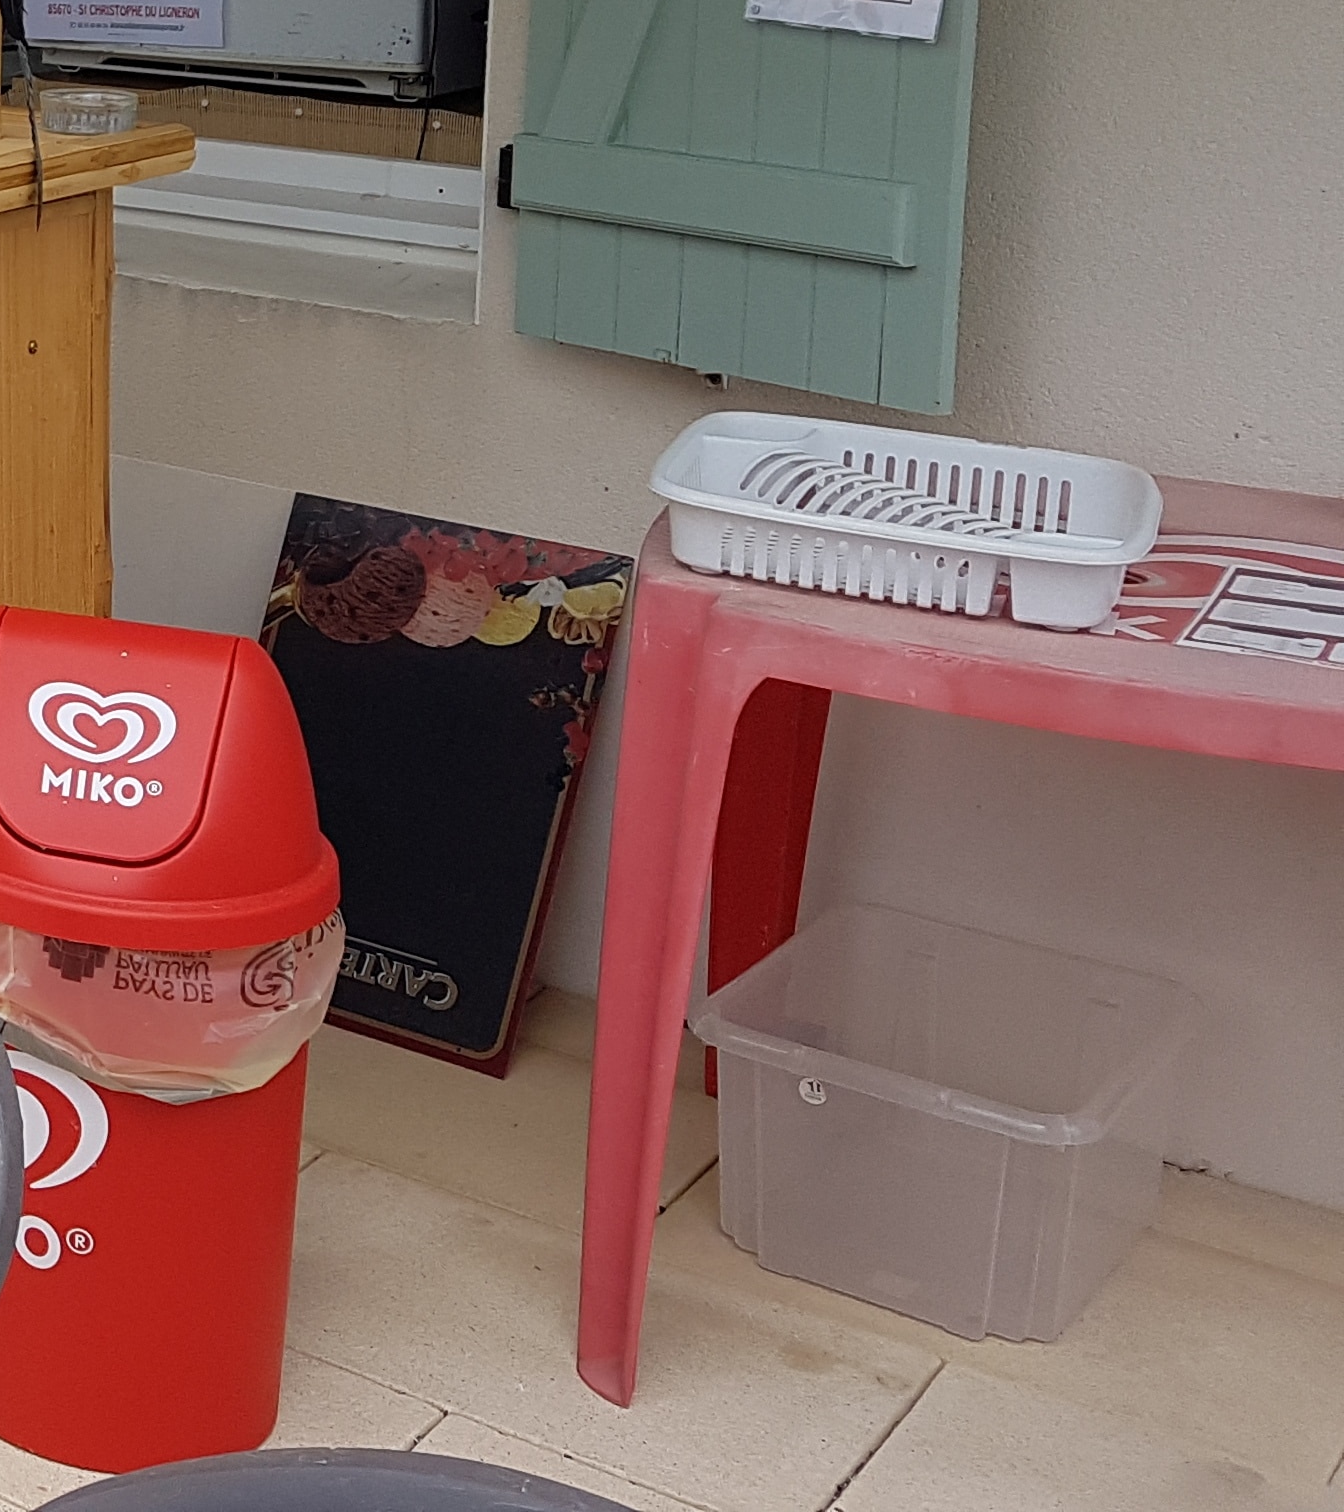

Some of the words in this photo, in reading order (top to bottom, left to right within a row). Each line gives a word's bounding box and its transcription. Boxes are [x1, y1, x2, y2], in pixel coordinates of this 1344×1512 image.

[47, 3, 72, 16] 85670
[89, 3, 143, 18] CHRISTOPHE
[145, 5, 156, 18] DU
[159, 6, 200, 19] LIGNERON
